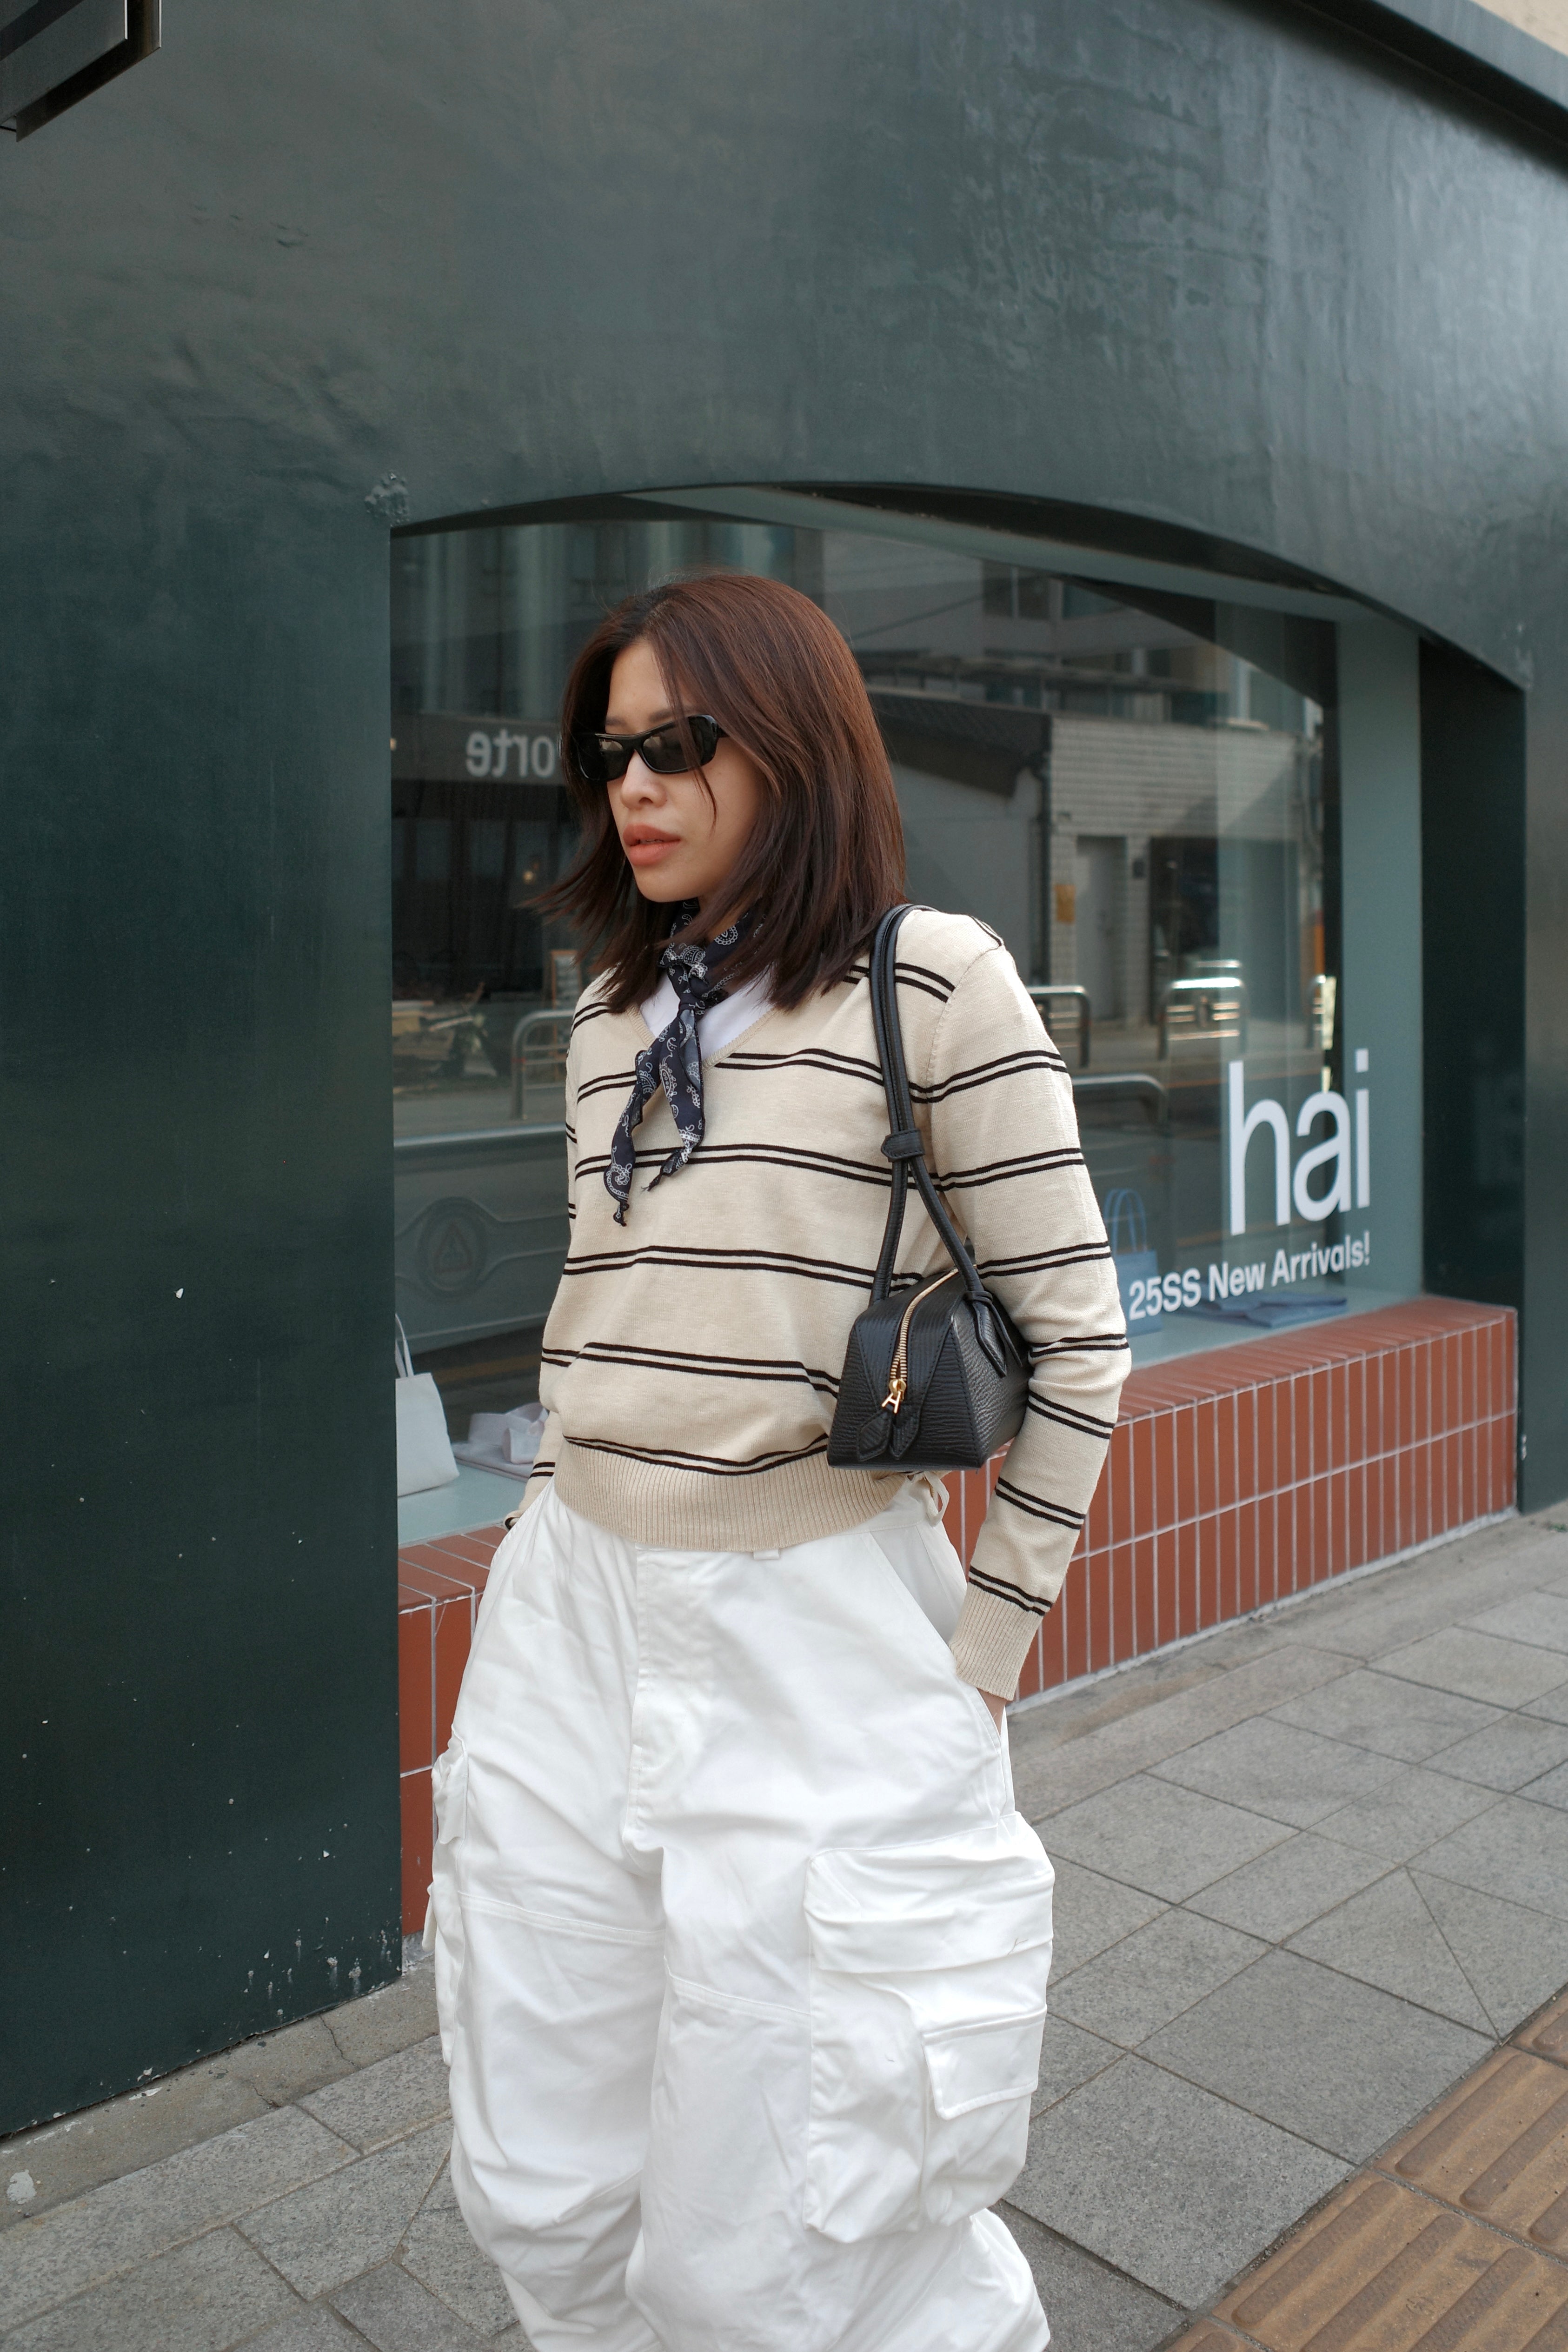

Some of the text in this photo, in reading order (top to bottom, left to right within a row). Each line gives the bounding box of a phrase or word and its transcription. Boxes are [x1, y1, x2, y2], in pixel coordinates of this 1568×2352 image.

[1229, 1048, 1370, 1236] hai
[1129, 1230, 1370, 1321] 25SS New Arrivals!
